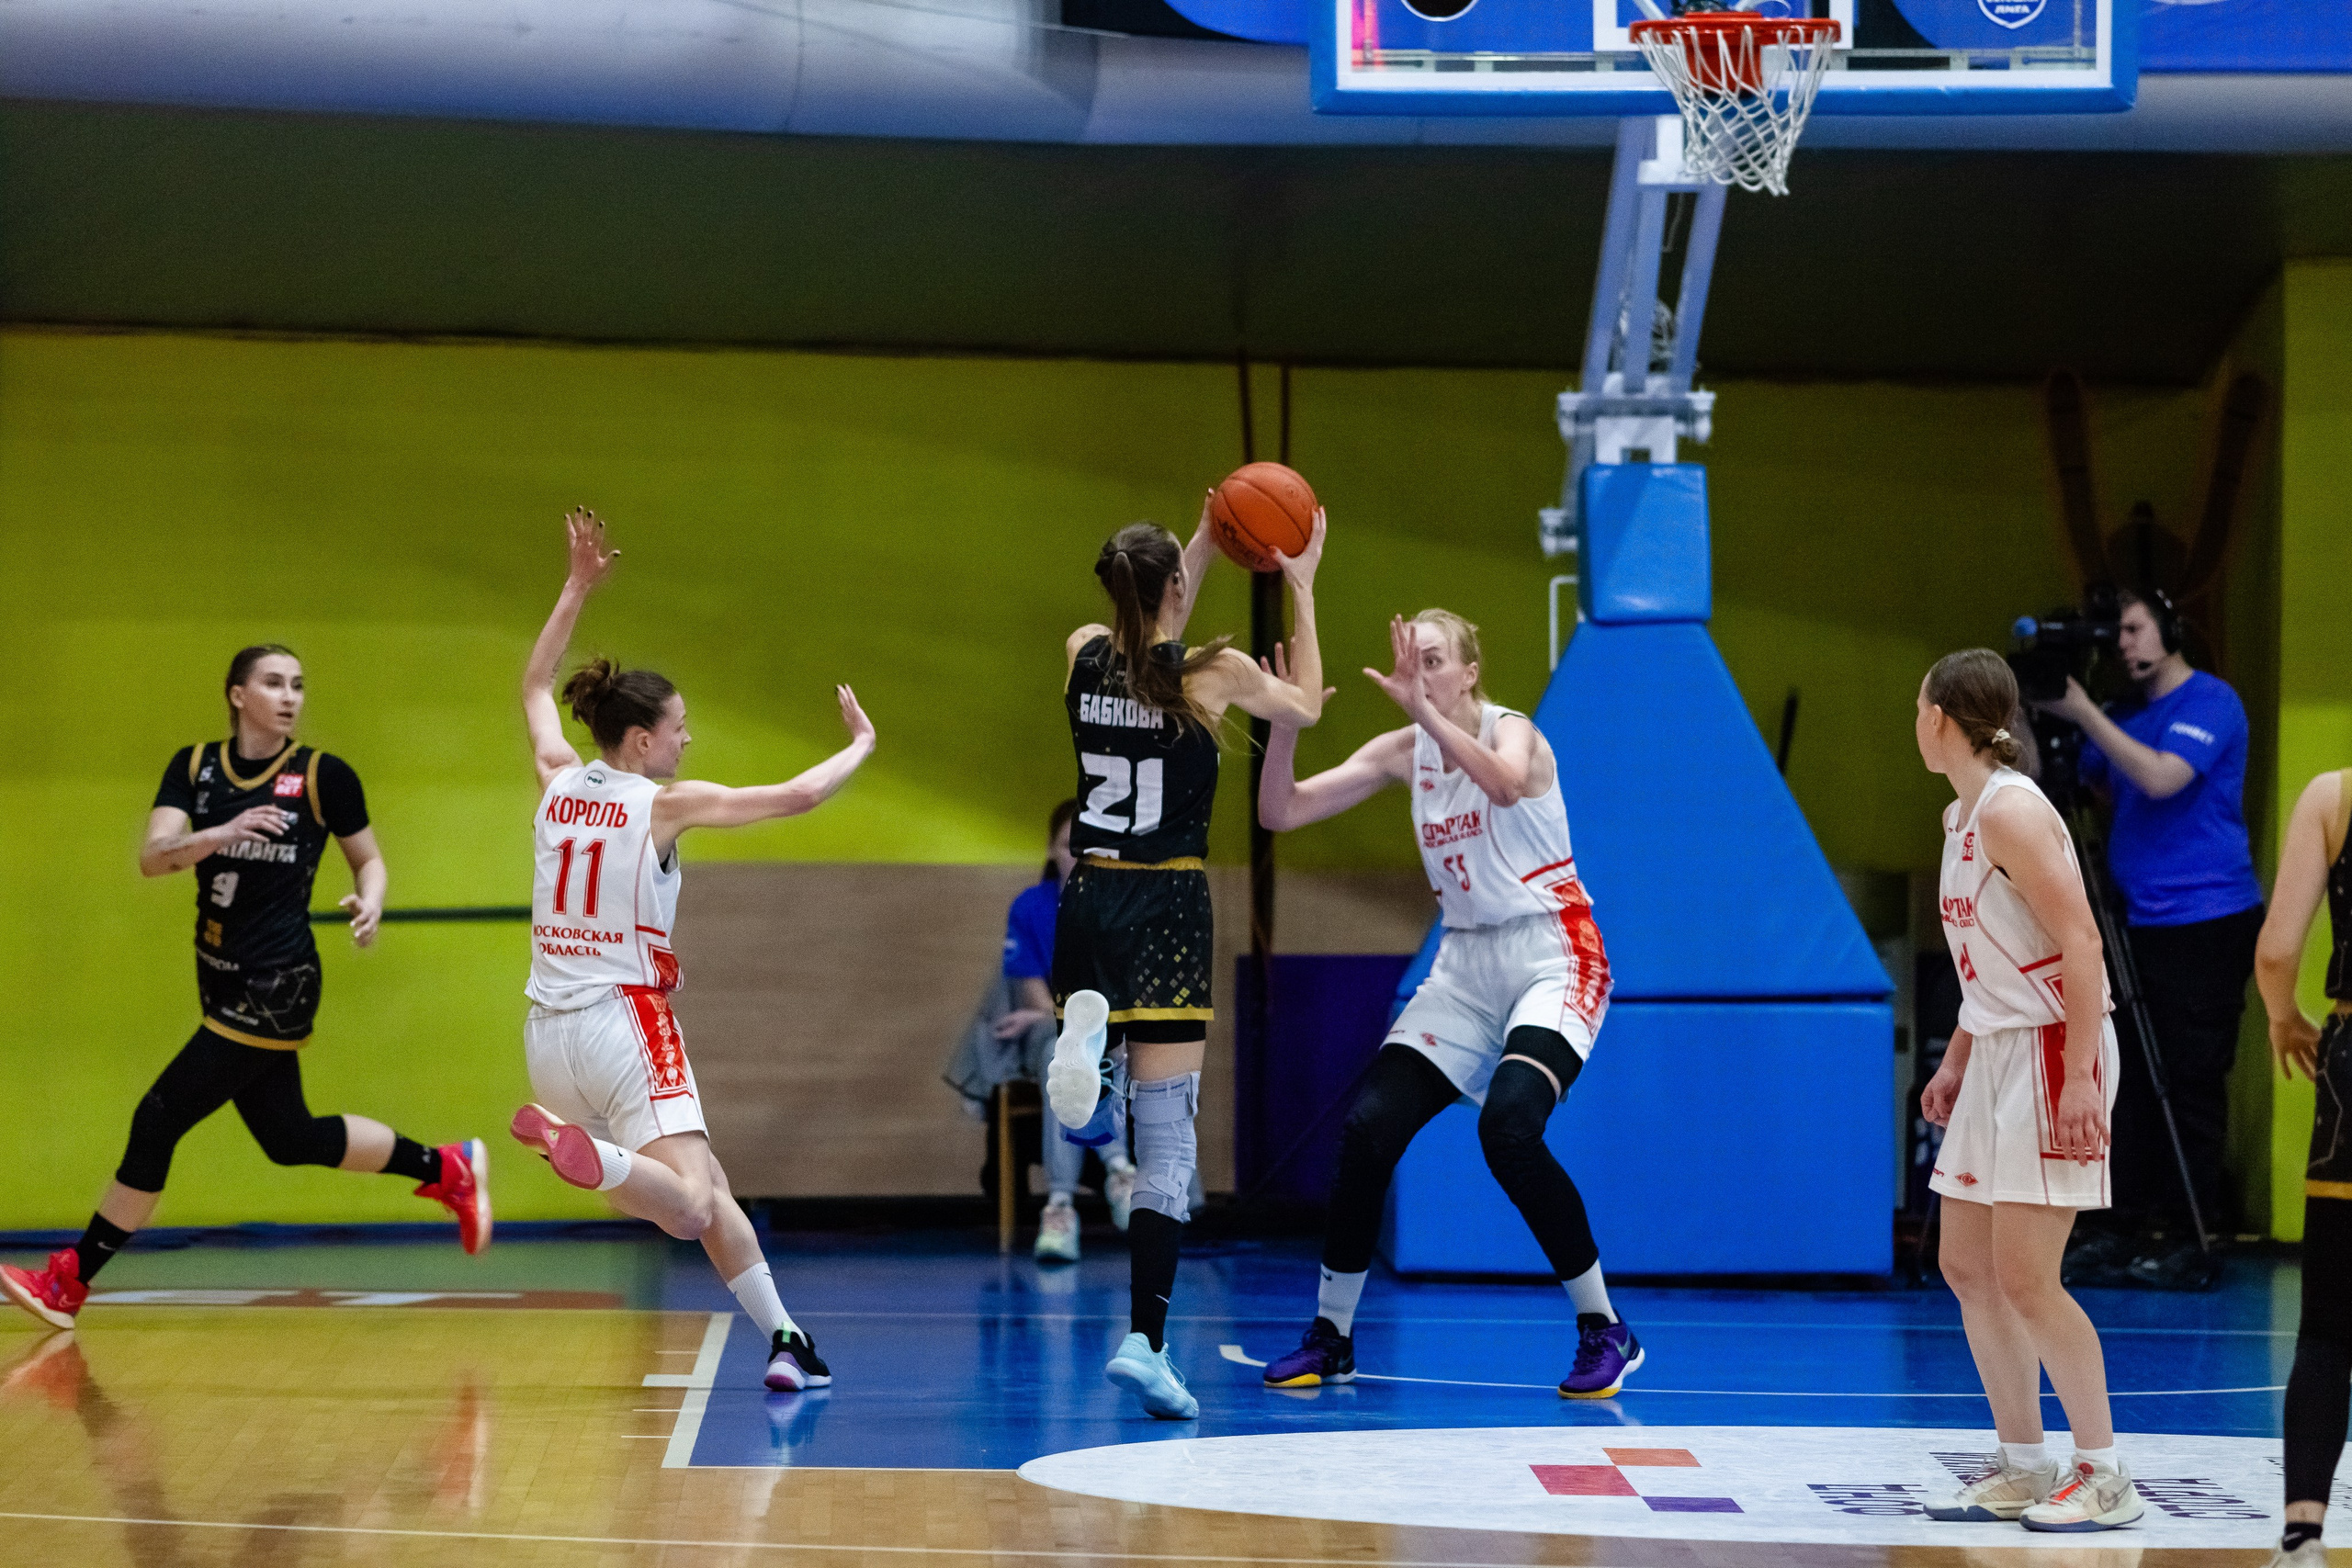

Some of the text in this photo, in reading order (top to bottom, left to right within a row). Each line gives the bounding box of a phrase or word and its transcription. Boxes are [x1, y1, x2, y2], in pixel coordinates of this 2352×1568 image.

[1079, 751, 1164, 836] 21
[546, 795, 628, 829] КОРОЛЬ
[210, 871, 239, 908] 9
[552, 836, 606, 919] 11
[534, 924, 624, 944] ОСКОВСКАЯ
[1805, 1483, 1928, 1517] ФОНД
